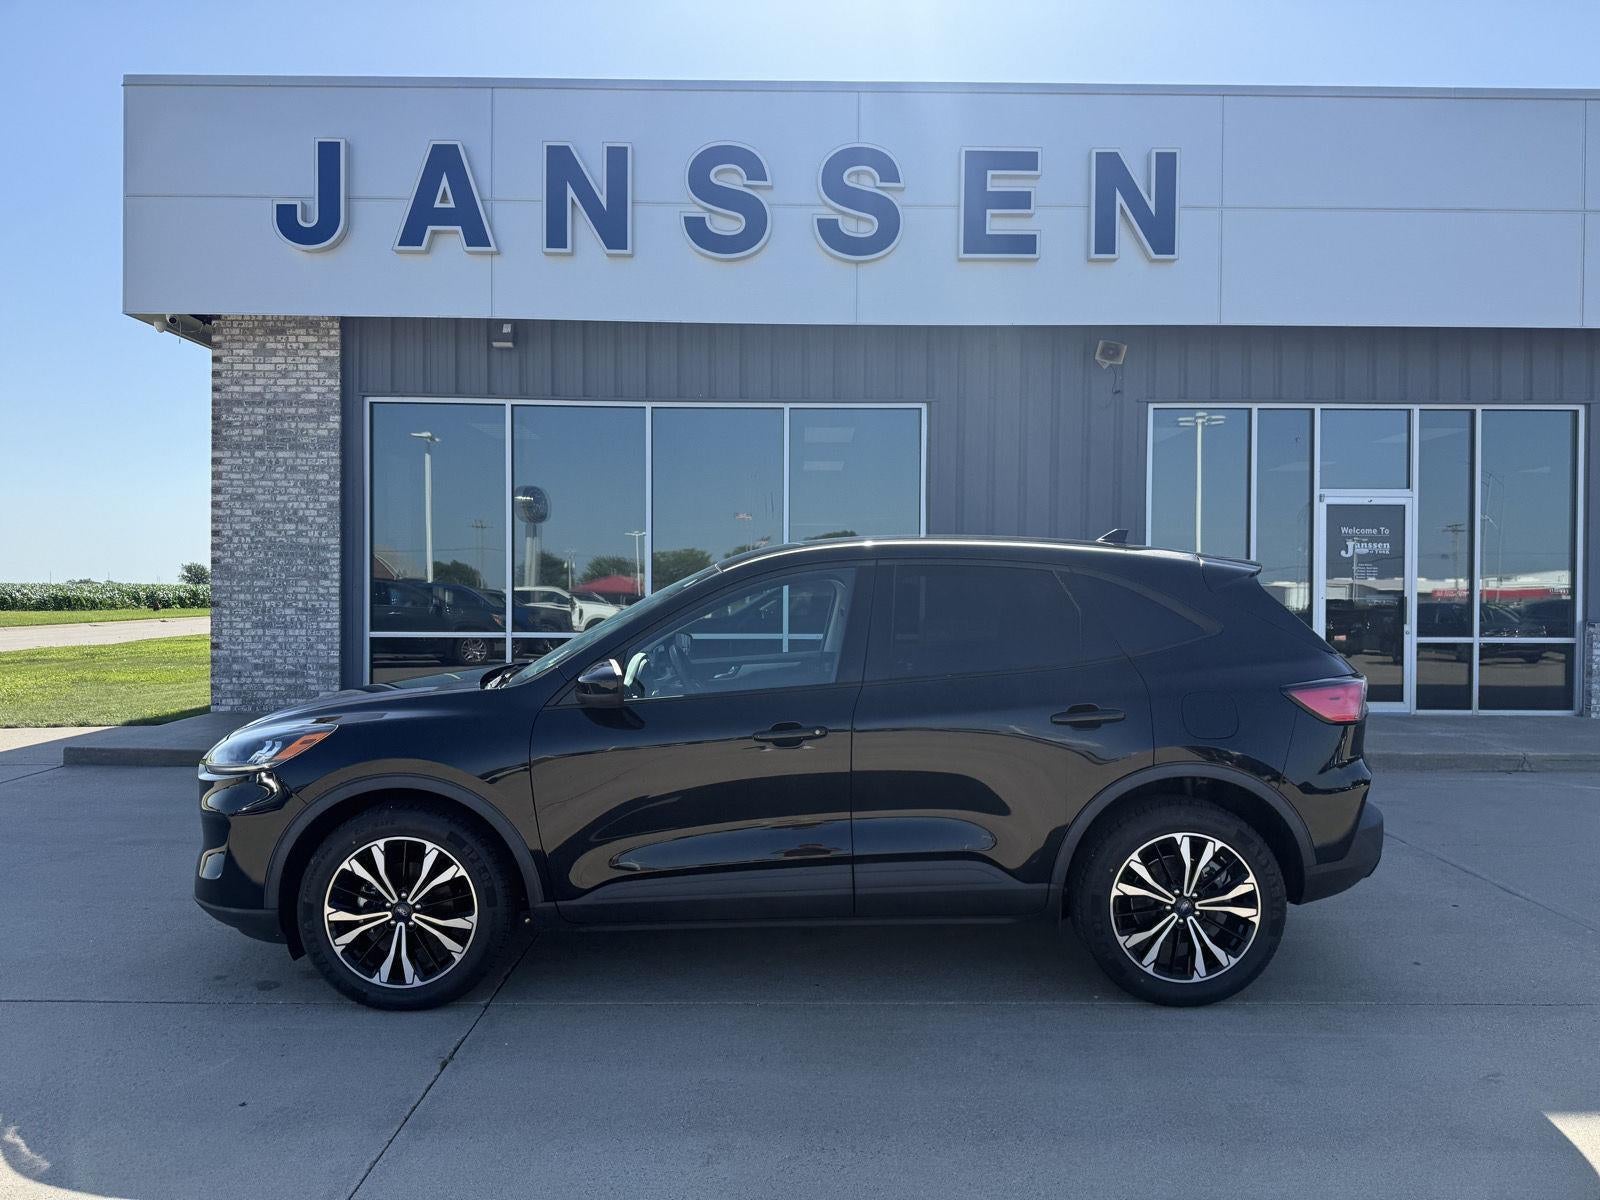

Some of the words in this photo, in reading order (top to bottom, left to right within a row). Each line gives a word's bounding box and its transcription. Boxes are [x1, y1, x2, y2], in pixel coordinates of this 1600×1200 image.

[272, 137, 1181, 261] JANSSEN
[1340, 526, 1377, 534] Welcome
[1340, 541, 1390, 557] Janssen
